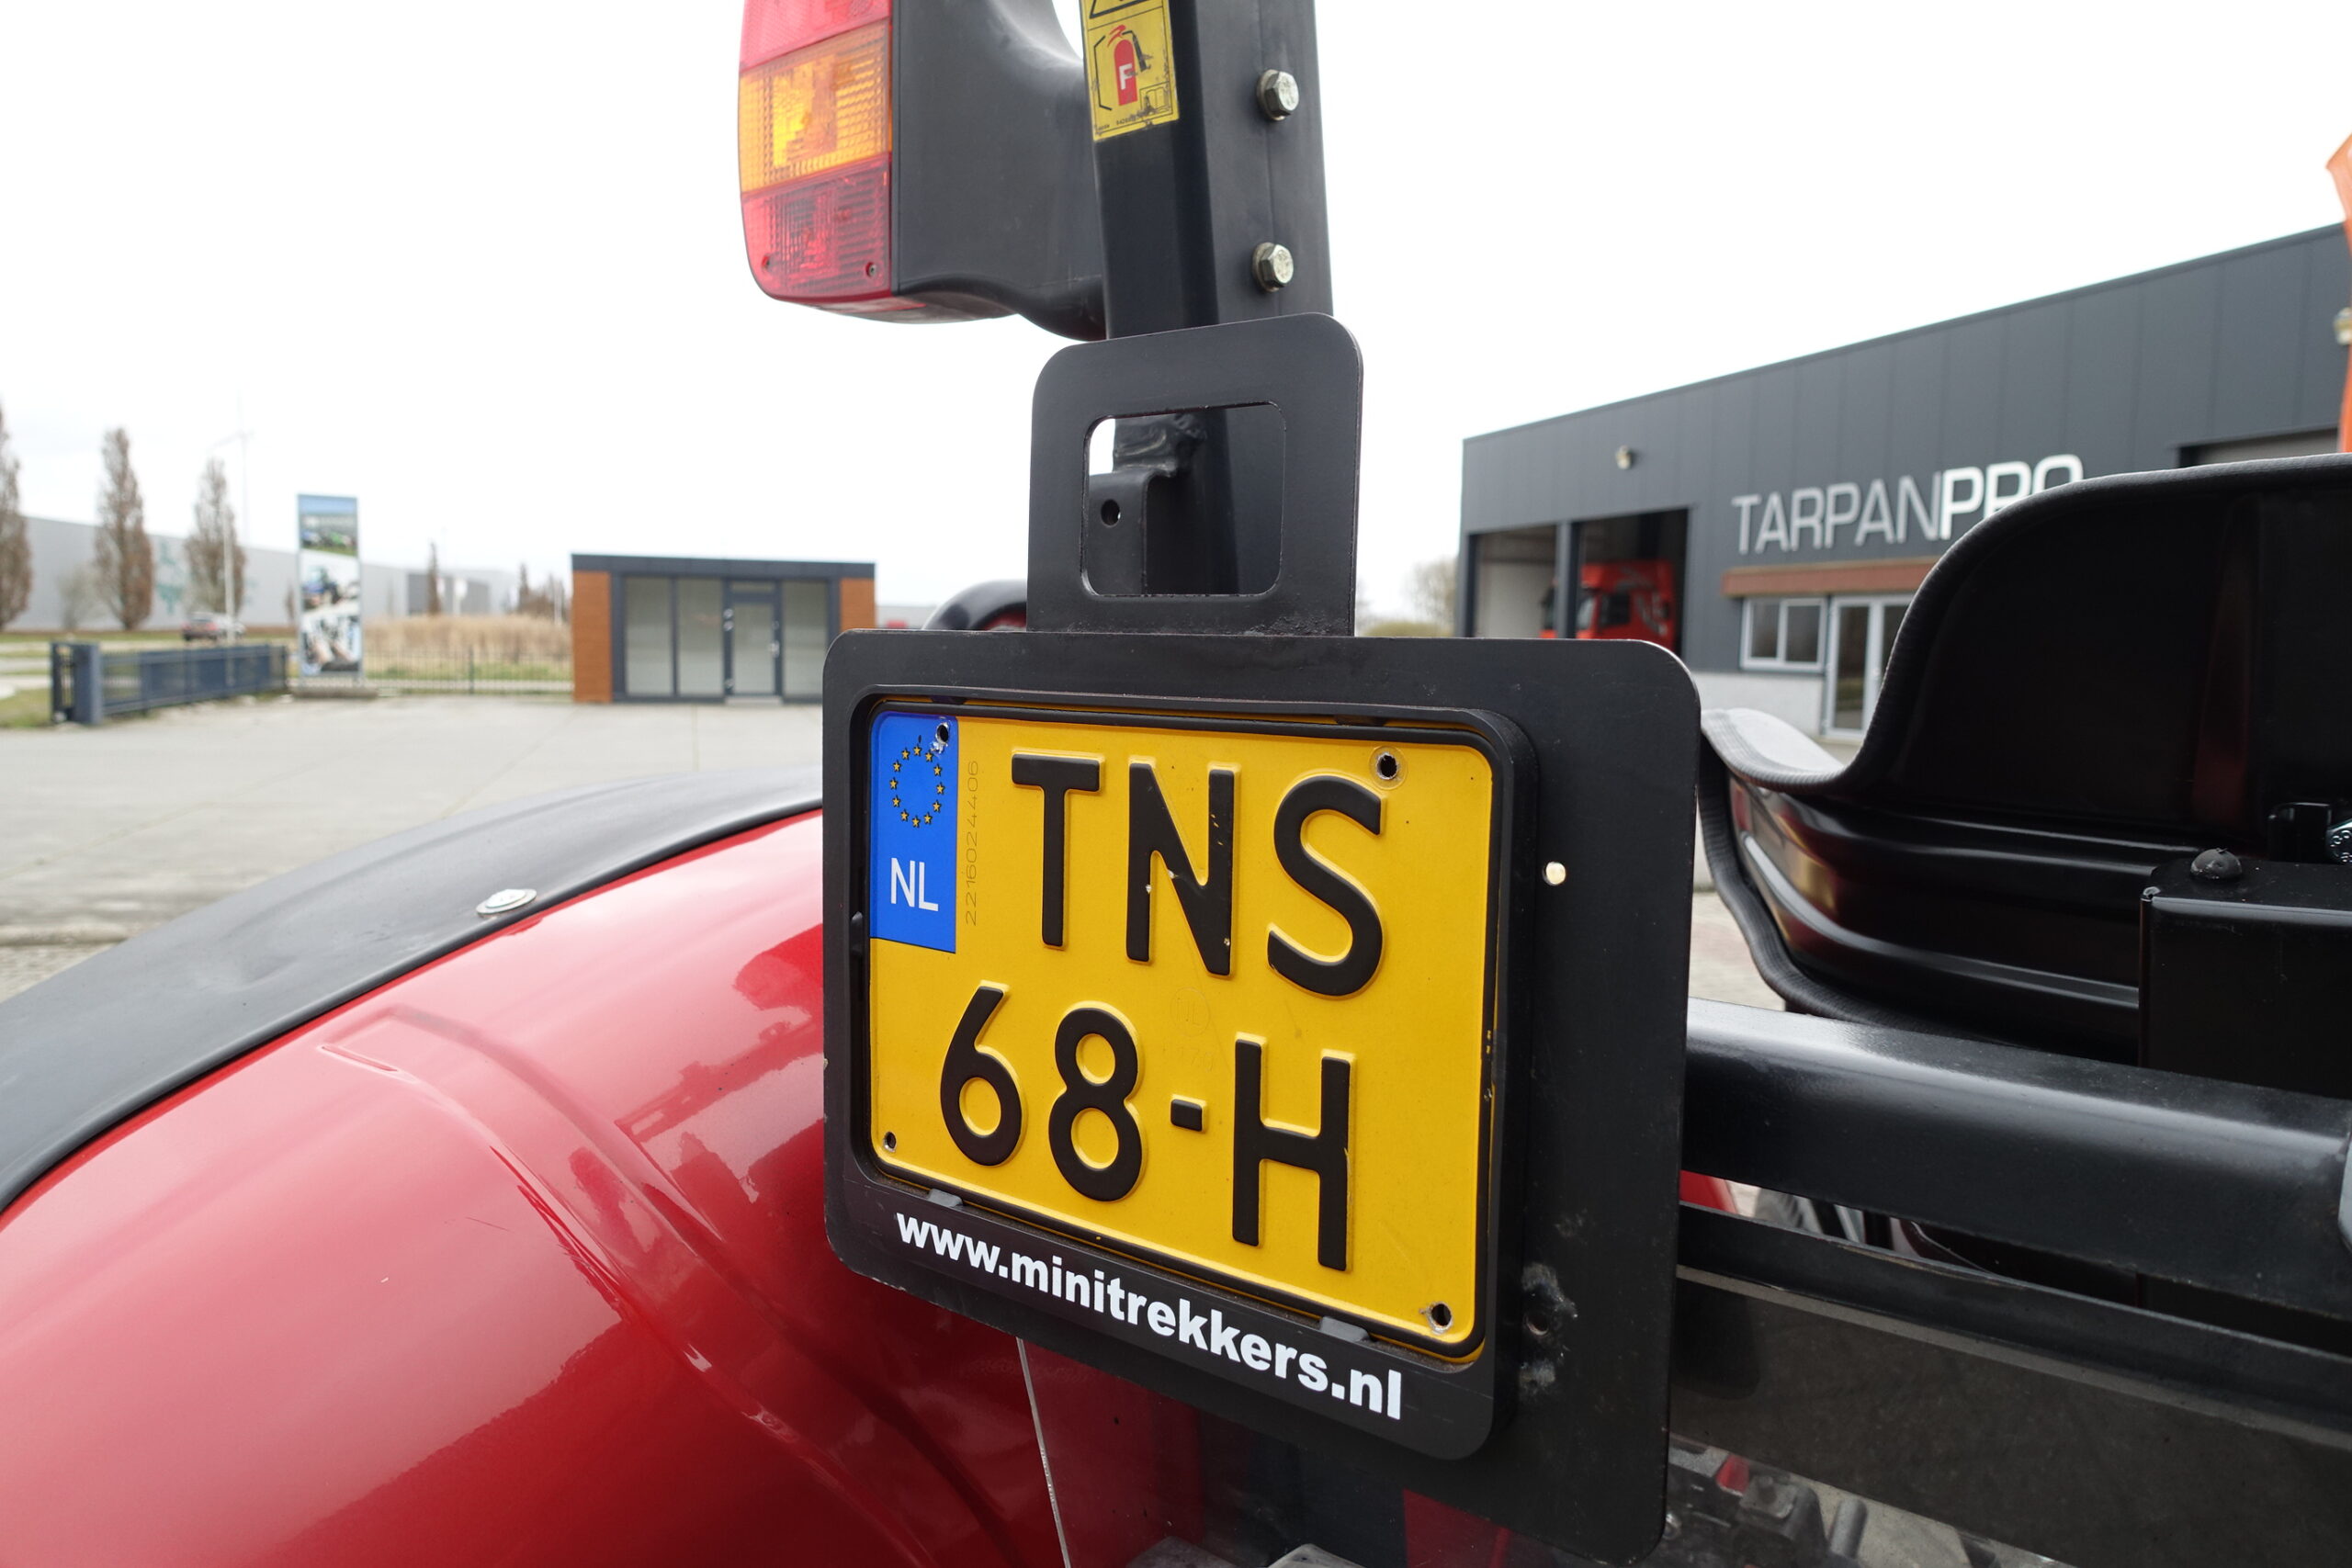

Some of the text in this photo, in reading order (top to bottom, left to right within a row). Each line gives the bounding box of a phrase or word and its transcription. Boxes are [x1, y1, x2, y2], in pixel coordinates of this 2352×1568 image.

[1118, 62, 1134, 90] F
[890, 857, 939, 912] NL
[965, 760, 979, 927] 2216024406
[1011, 753, 1385, 998] TNS
[940, 985, 1351, 1271] 68-H
[896, 1211, 1402, 1420] www.minitrekkers.nl
